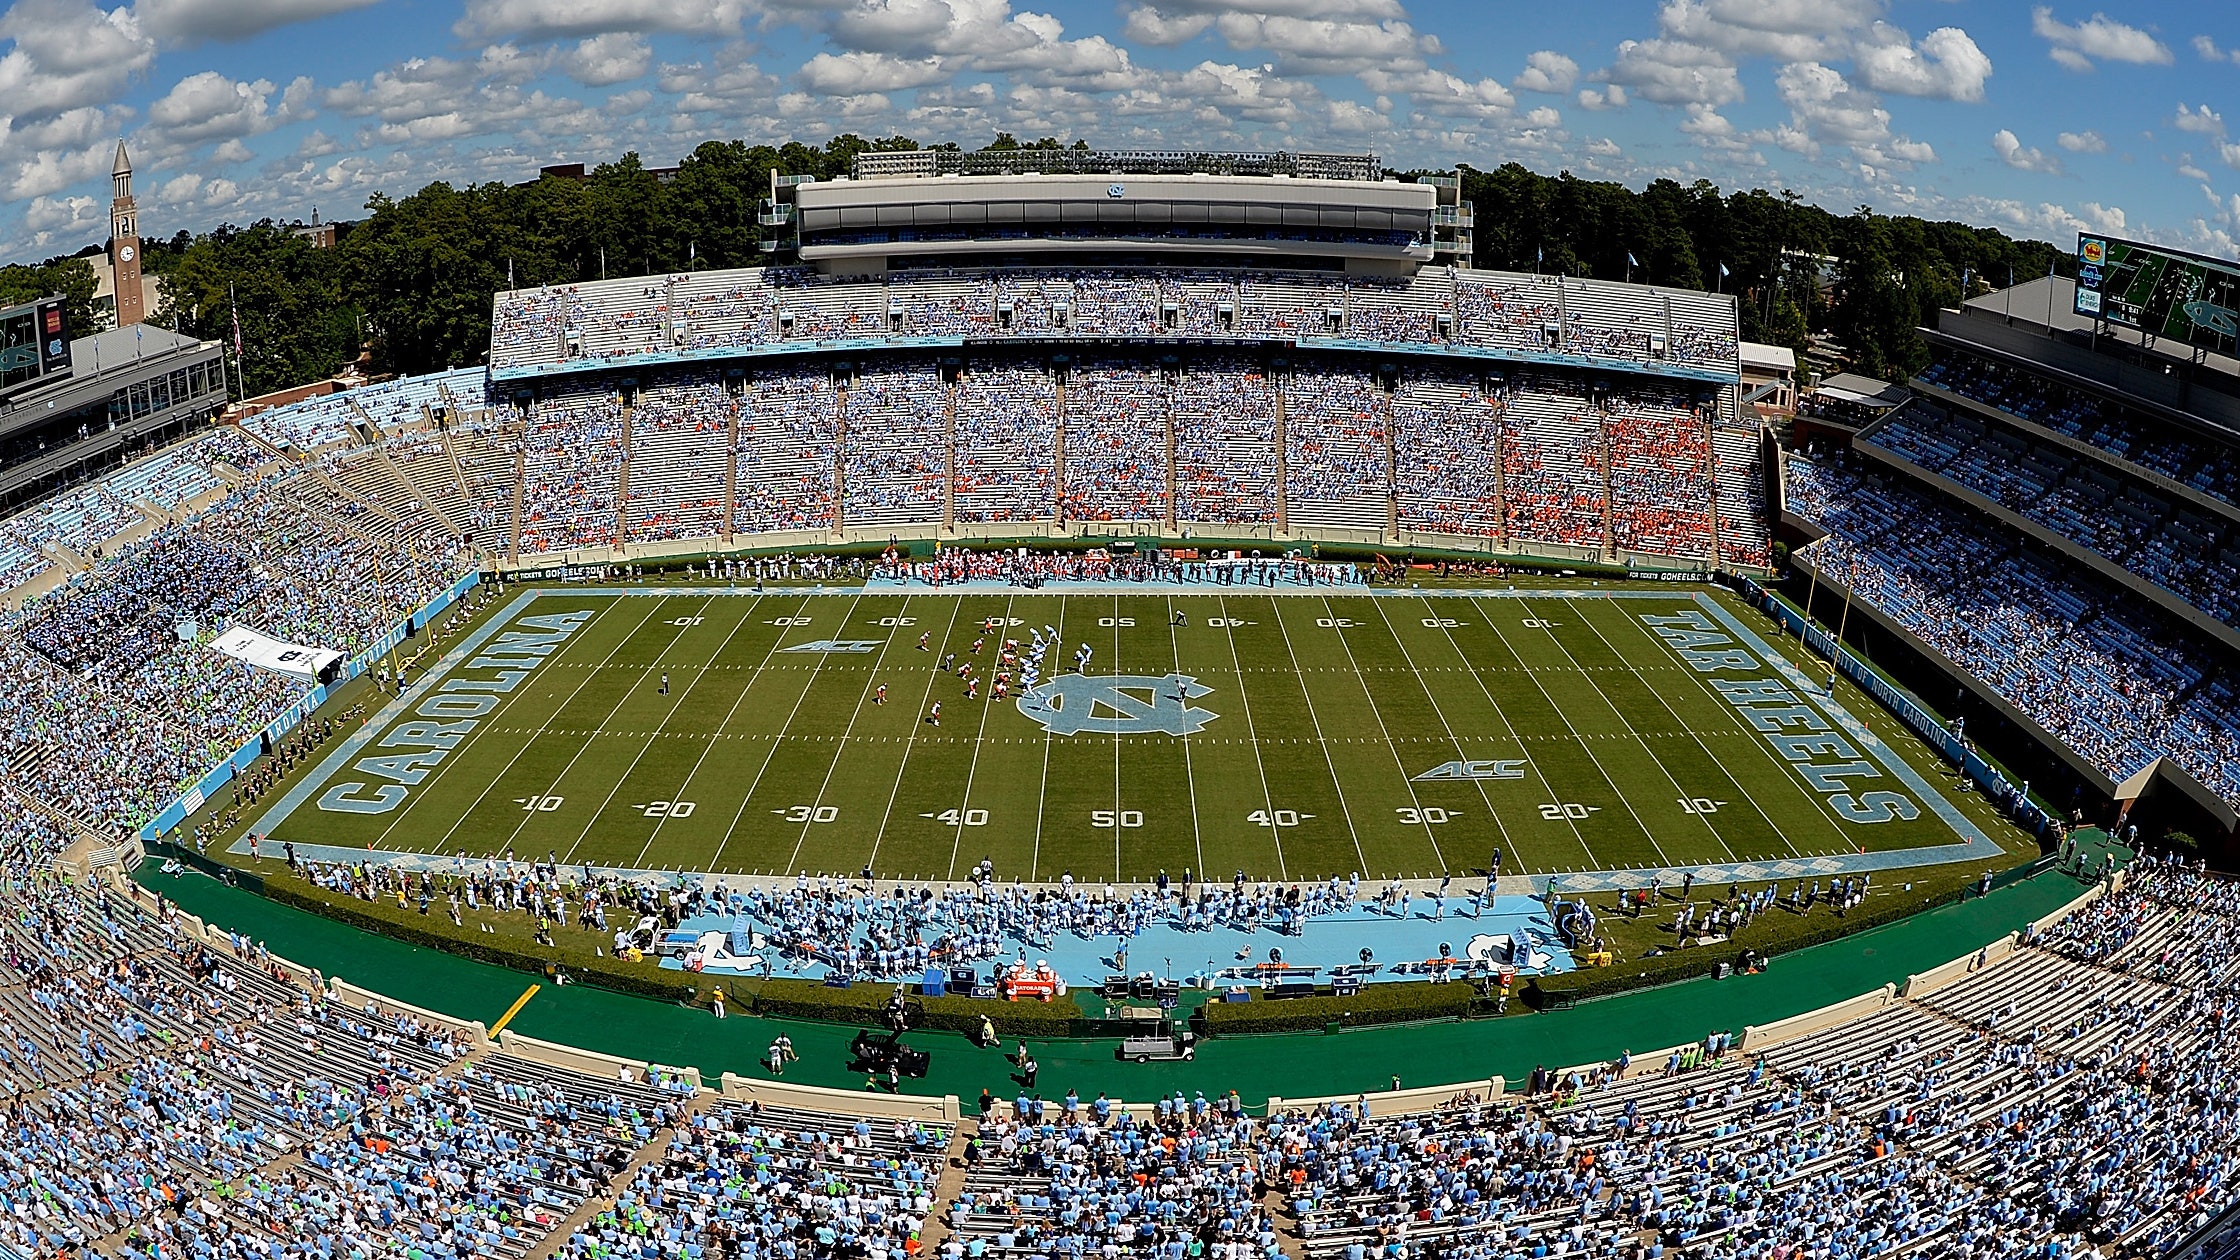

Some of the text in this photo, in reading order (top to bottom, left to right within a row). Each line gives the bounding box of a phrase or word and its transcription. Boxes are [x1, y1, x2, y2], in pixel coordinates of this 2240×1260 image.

[775, 640, 886, 654] ACC
[1808, 628, 1947, 750] UNIVERSITY OF NORTH CAROLINA
[316, 610, 596, 815] CAROLINA
[1639, 611, 1921, 824] TAR HEELS
[1409, 760, 1528, 781] ACC
[522, 796, 564, 811] 10
[643, 801, 696, 818] 20
[1538, 804, 1589, 820] 20
[1677, 798, 1718, 814] 10
[785, 806, 839, 823] 30
[937, 809, 989, 826] 40
[1091, 810, 1144, 827] 50
[1247, 809, 1300, 827] 40
[1396, 807, 1449, 824] 30
